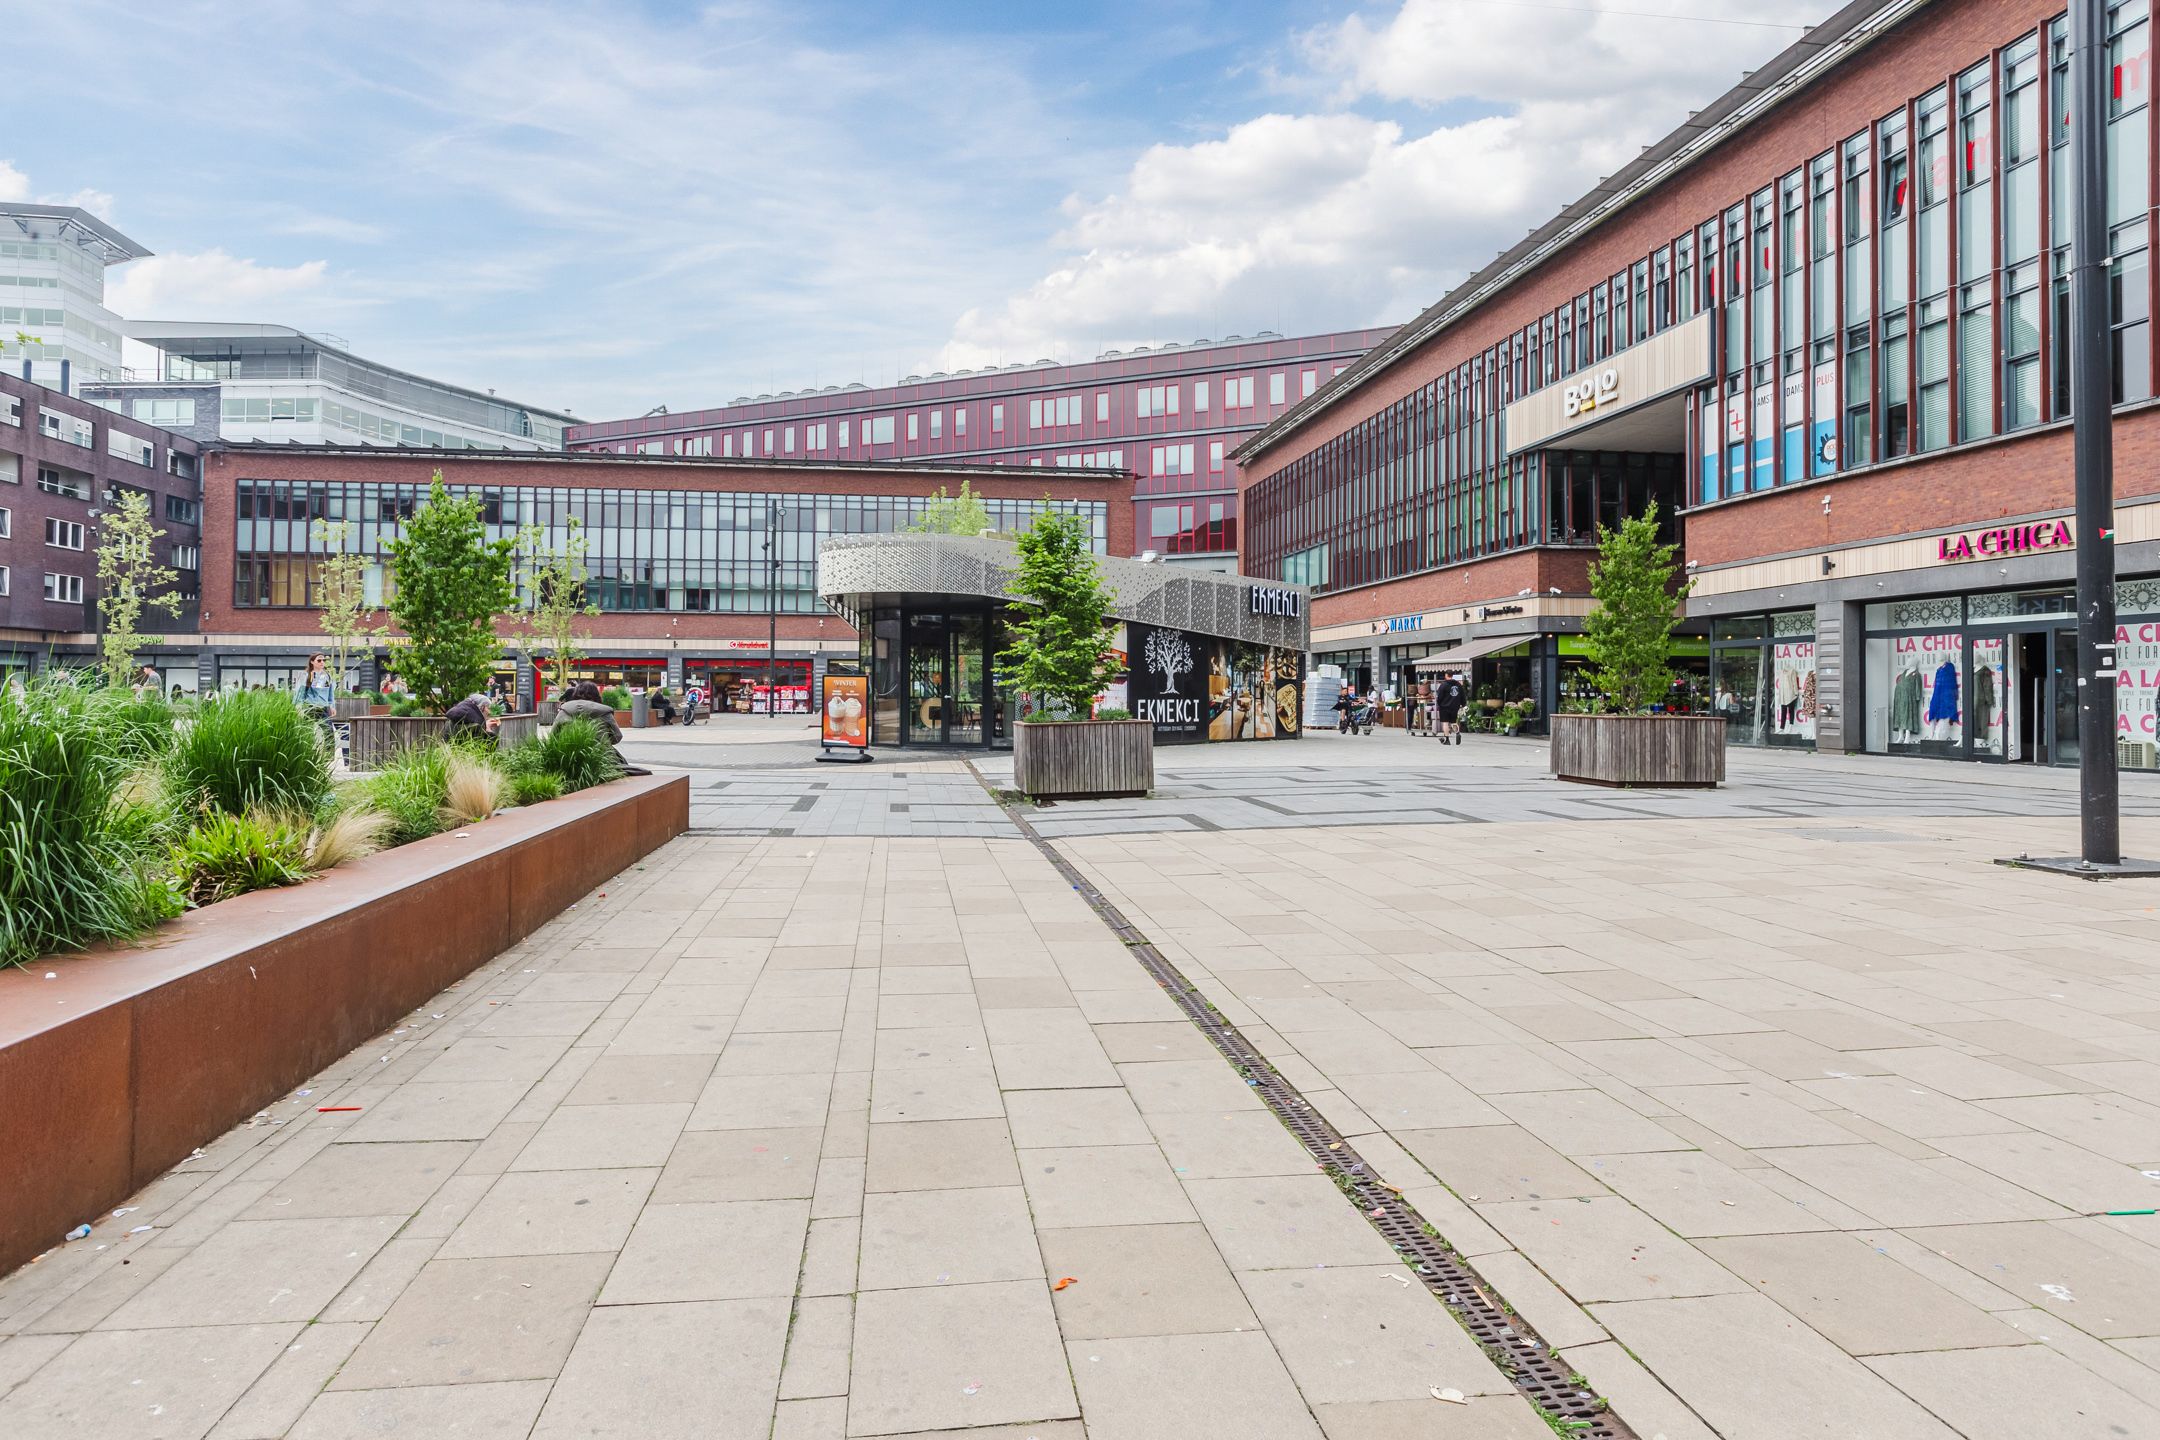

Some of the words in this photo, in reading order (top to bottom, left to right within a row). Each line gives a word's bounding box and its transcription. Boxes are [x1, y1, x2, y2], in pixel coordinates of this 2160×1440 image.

[1817, 373, 1834, 387] PLUS
[1938, 534, 1973, 560] LA
[1977, 520, 2072, 555] CHICA
[1252, 586, 1300, 617] EKMEKCI
[1390, 615, 1423, 632] MARKT
[1897, 637, 1917, 652] LA
[1922, 634, 1963, 651] CHIC
[2116, 626, 2131, 643] A
[1776, 645, 1791, 658] LA
[1137, 699, 1200, 723] EKMEKCI
